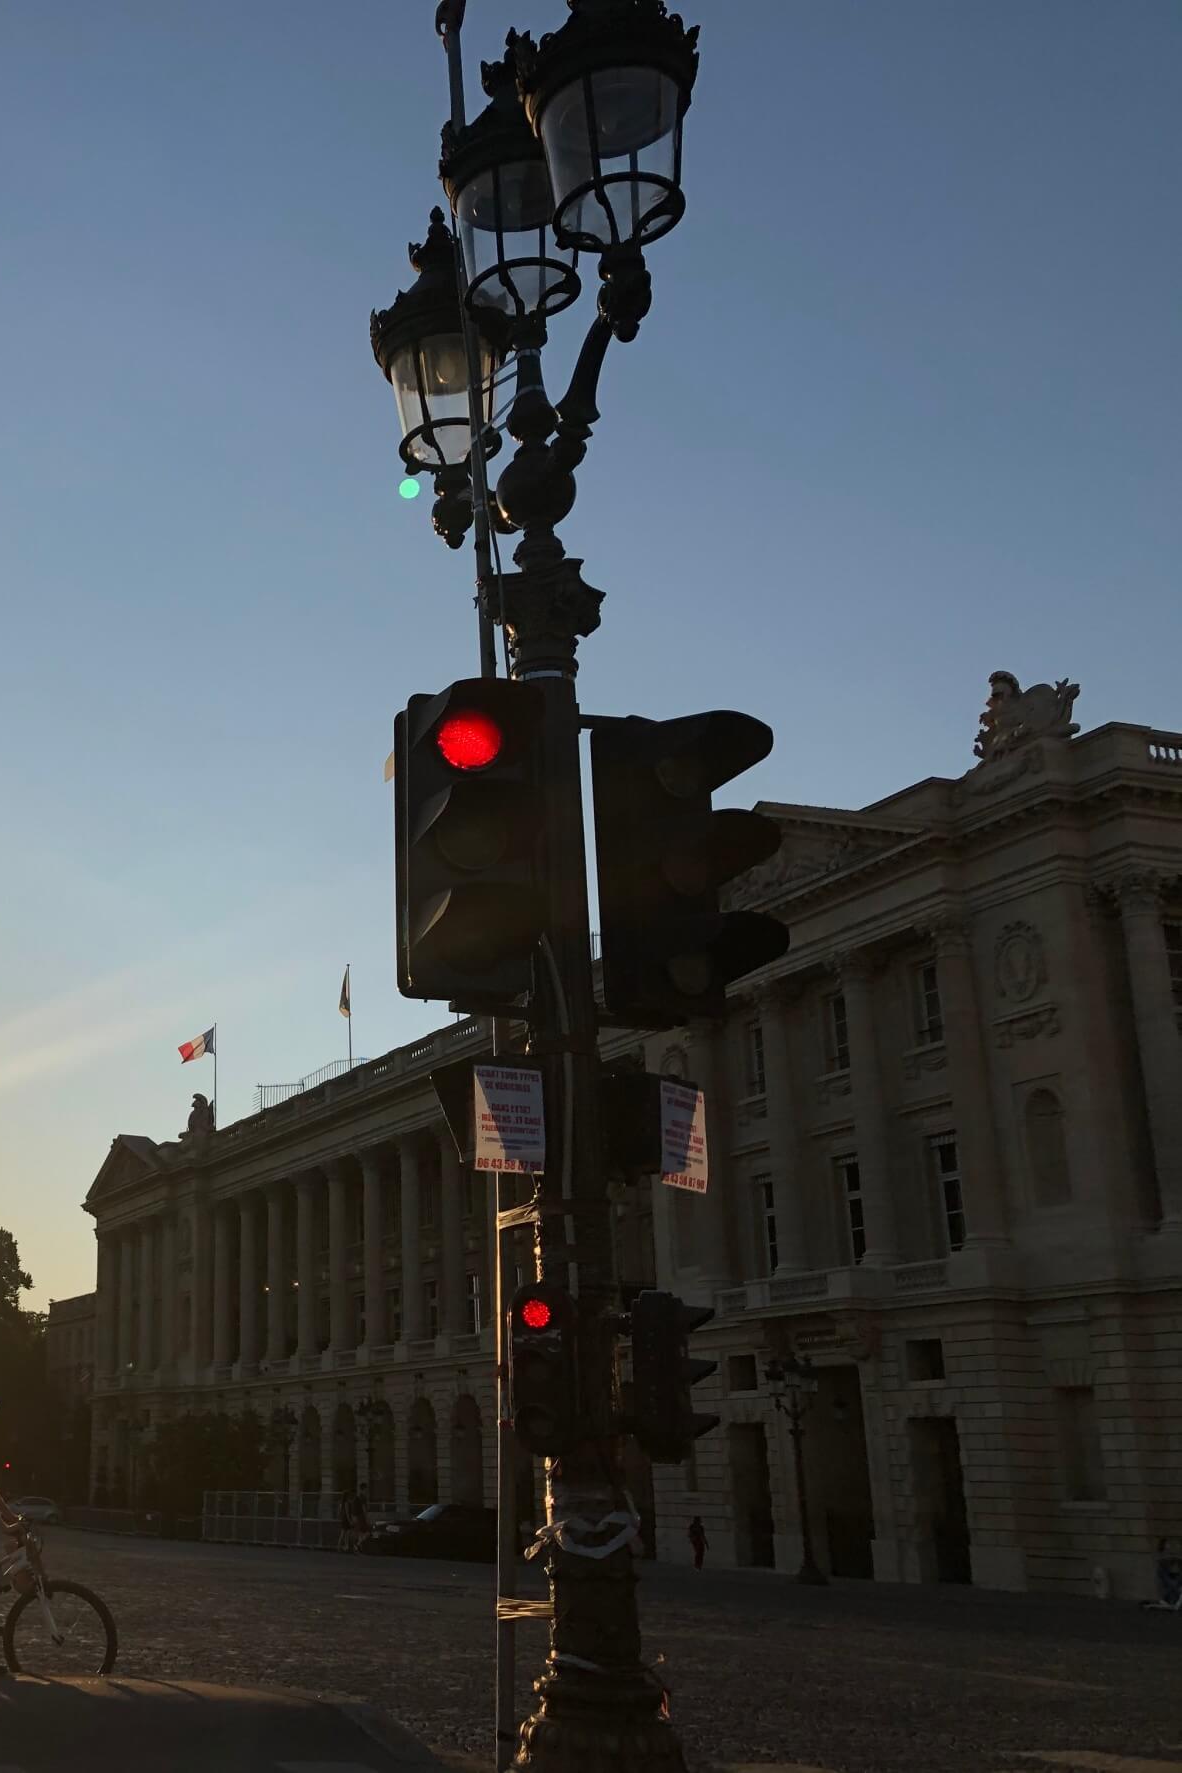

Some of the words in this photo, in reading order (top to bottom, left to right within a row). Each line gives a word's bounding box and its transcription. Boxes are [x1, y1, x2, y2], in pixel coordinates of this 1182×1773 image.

[477, 1157, 489, 1169] 06
[490, 1158, 503, 1170] 43
[504, 1159, 516, 1170] 58
[696, 1178, 705, 1190] 90
